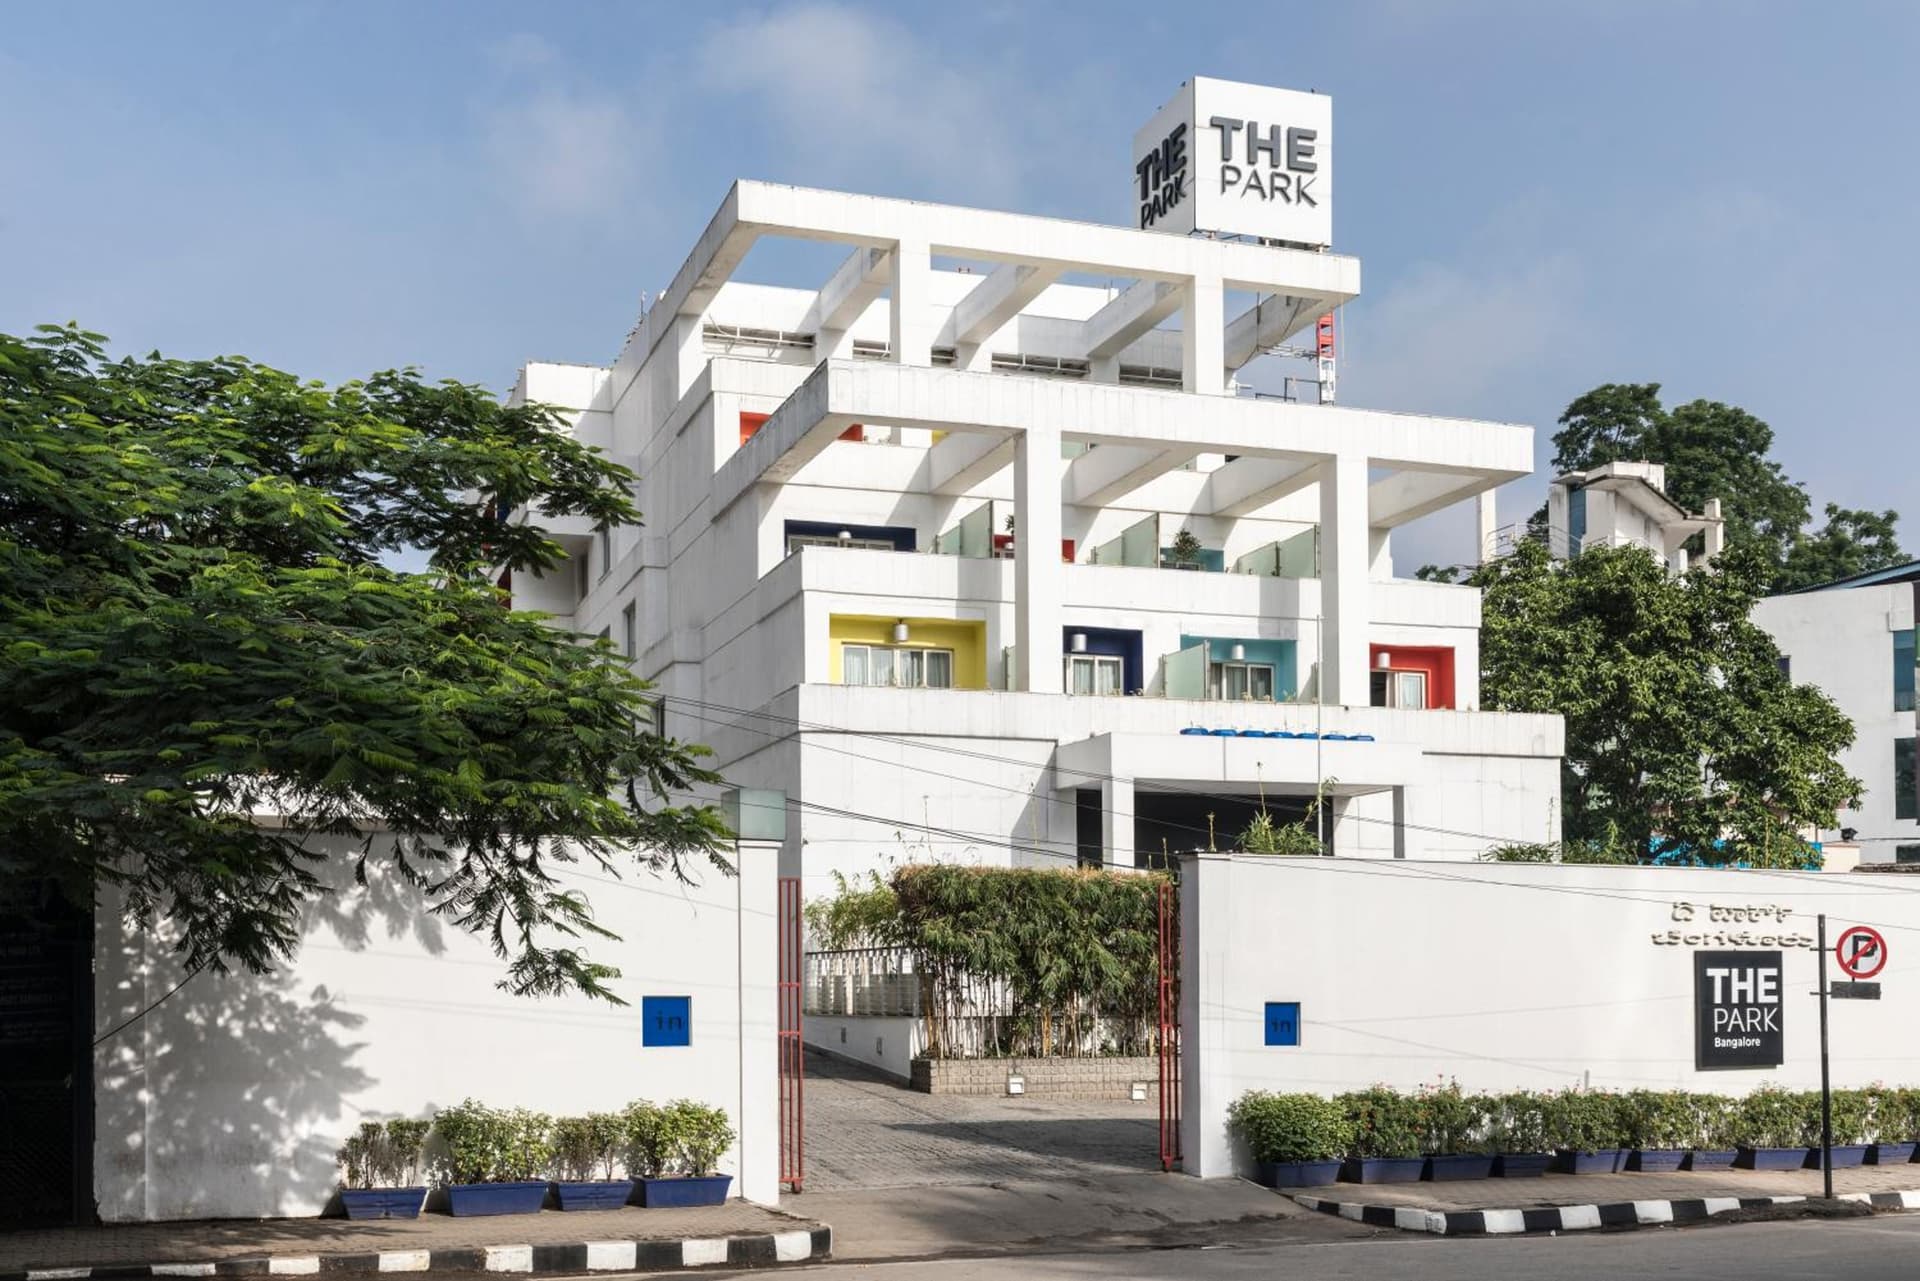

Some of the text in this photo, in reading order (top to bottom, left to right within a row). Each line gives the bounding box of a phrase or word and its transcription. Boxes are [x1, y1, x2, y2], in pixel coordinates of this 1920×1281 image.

[1136, 122, 1187, 201] THE
[1210, 115, 1317, 173] THE
[1140, 169, 1187, 231] PARK
[1219, 164, 1318, 208] PARK
[1852, 935, 1878, 969] P
[1706, 968, 1778, 1004] THE
[656, 1010, 682, 1031] in
[1714, 1008, 1779, 1032] PARK
[1714, 1037, 1760, 1049] Bangalore
